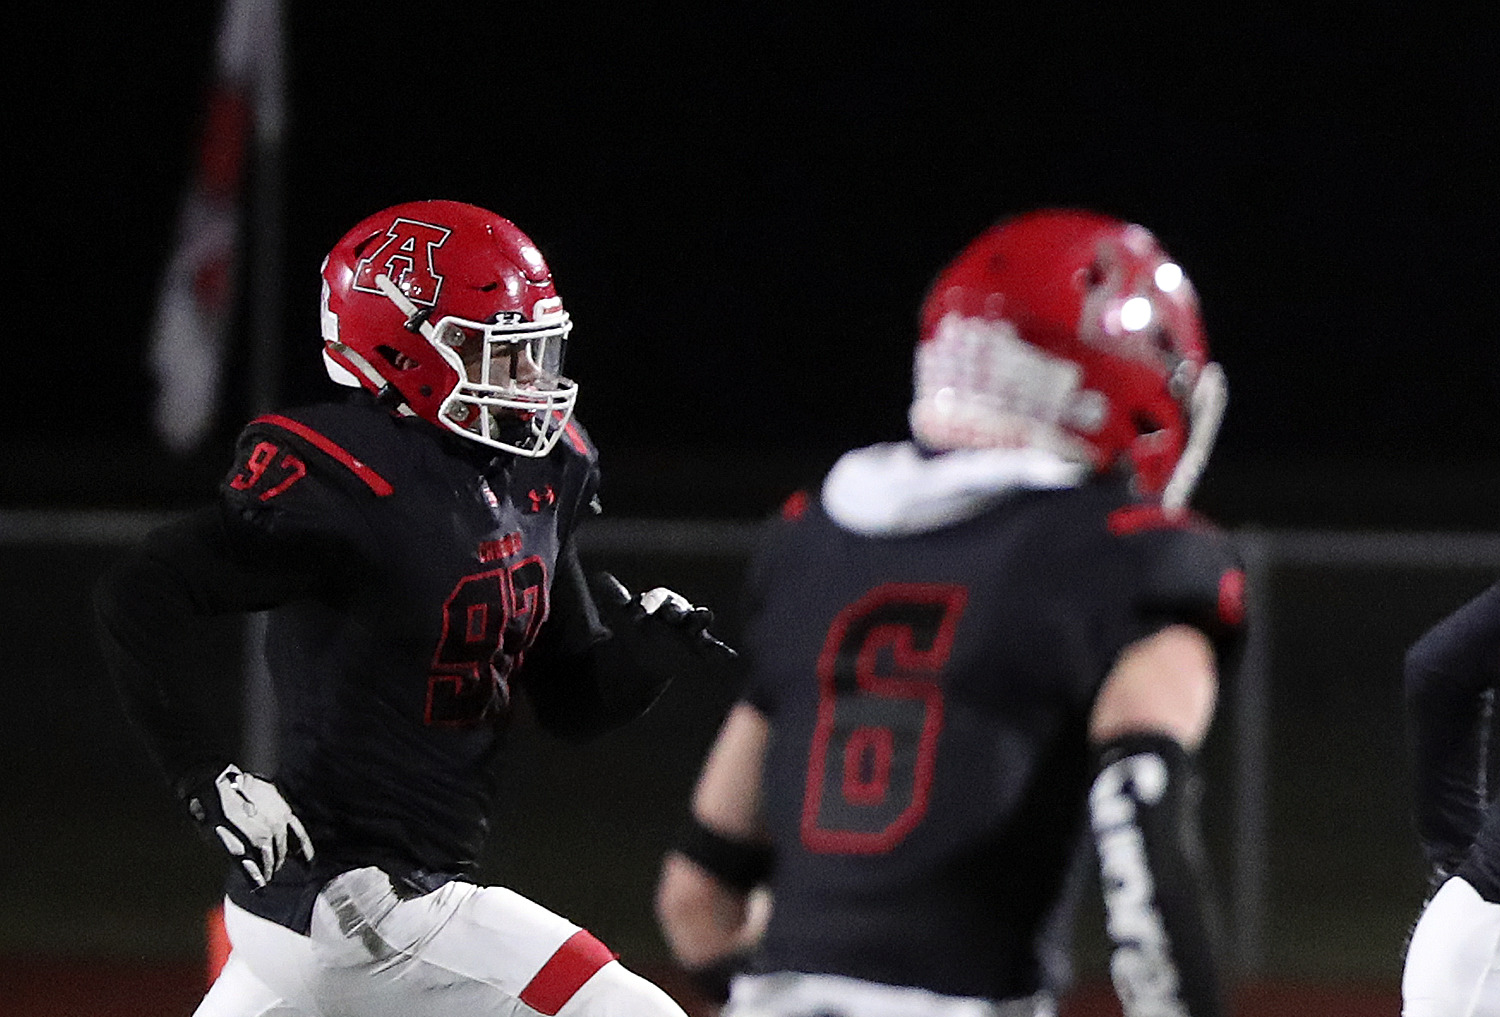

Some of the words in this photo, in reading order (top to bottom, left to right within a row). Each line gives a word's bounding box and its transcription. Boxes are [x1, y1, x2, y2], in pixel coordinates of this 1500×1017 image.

[353, 217, 452, 307] A
[229, 441, 306, 501] 97
[800, 582, 969, 855] 6
